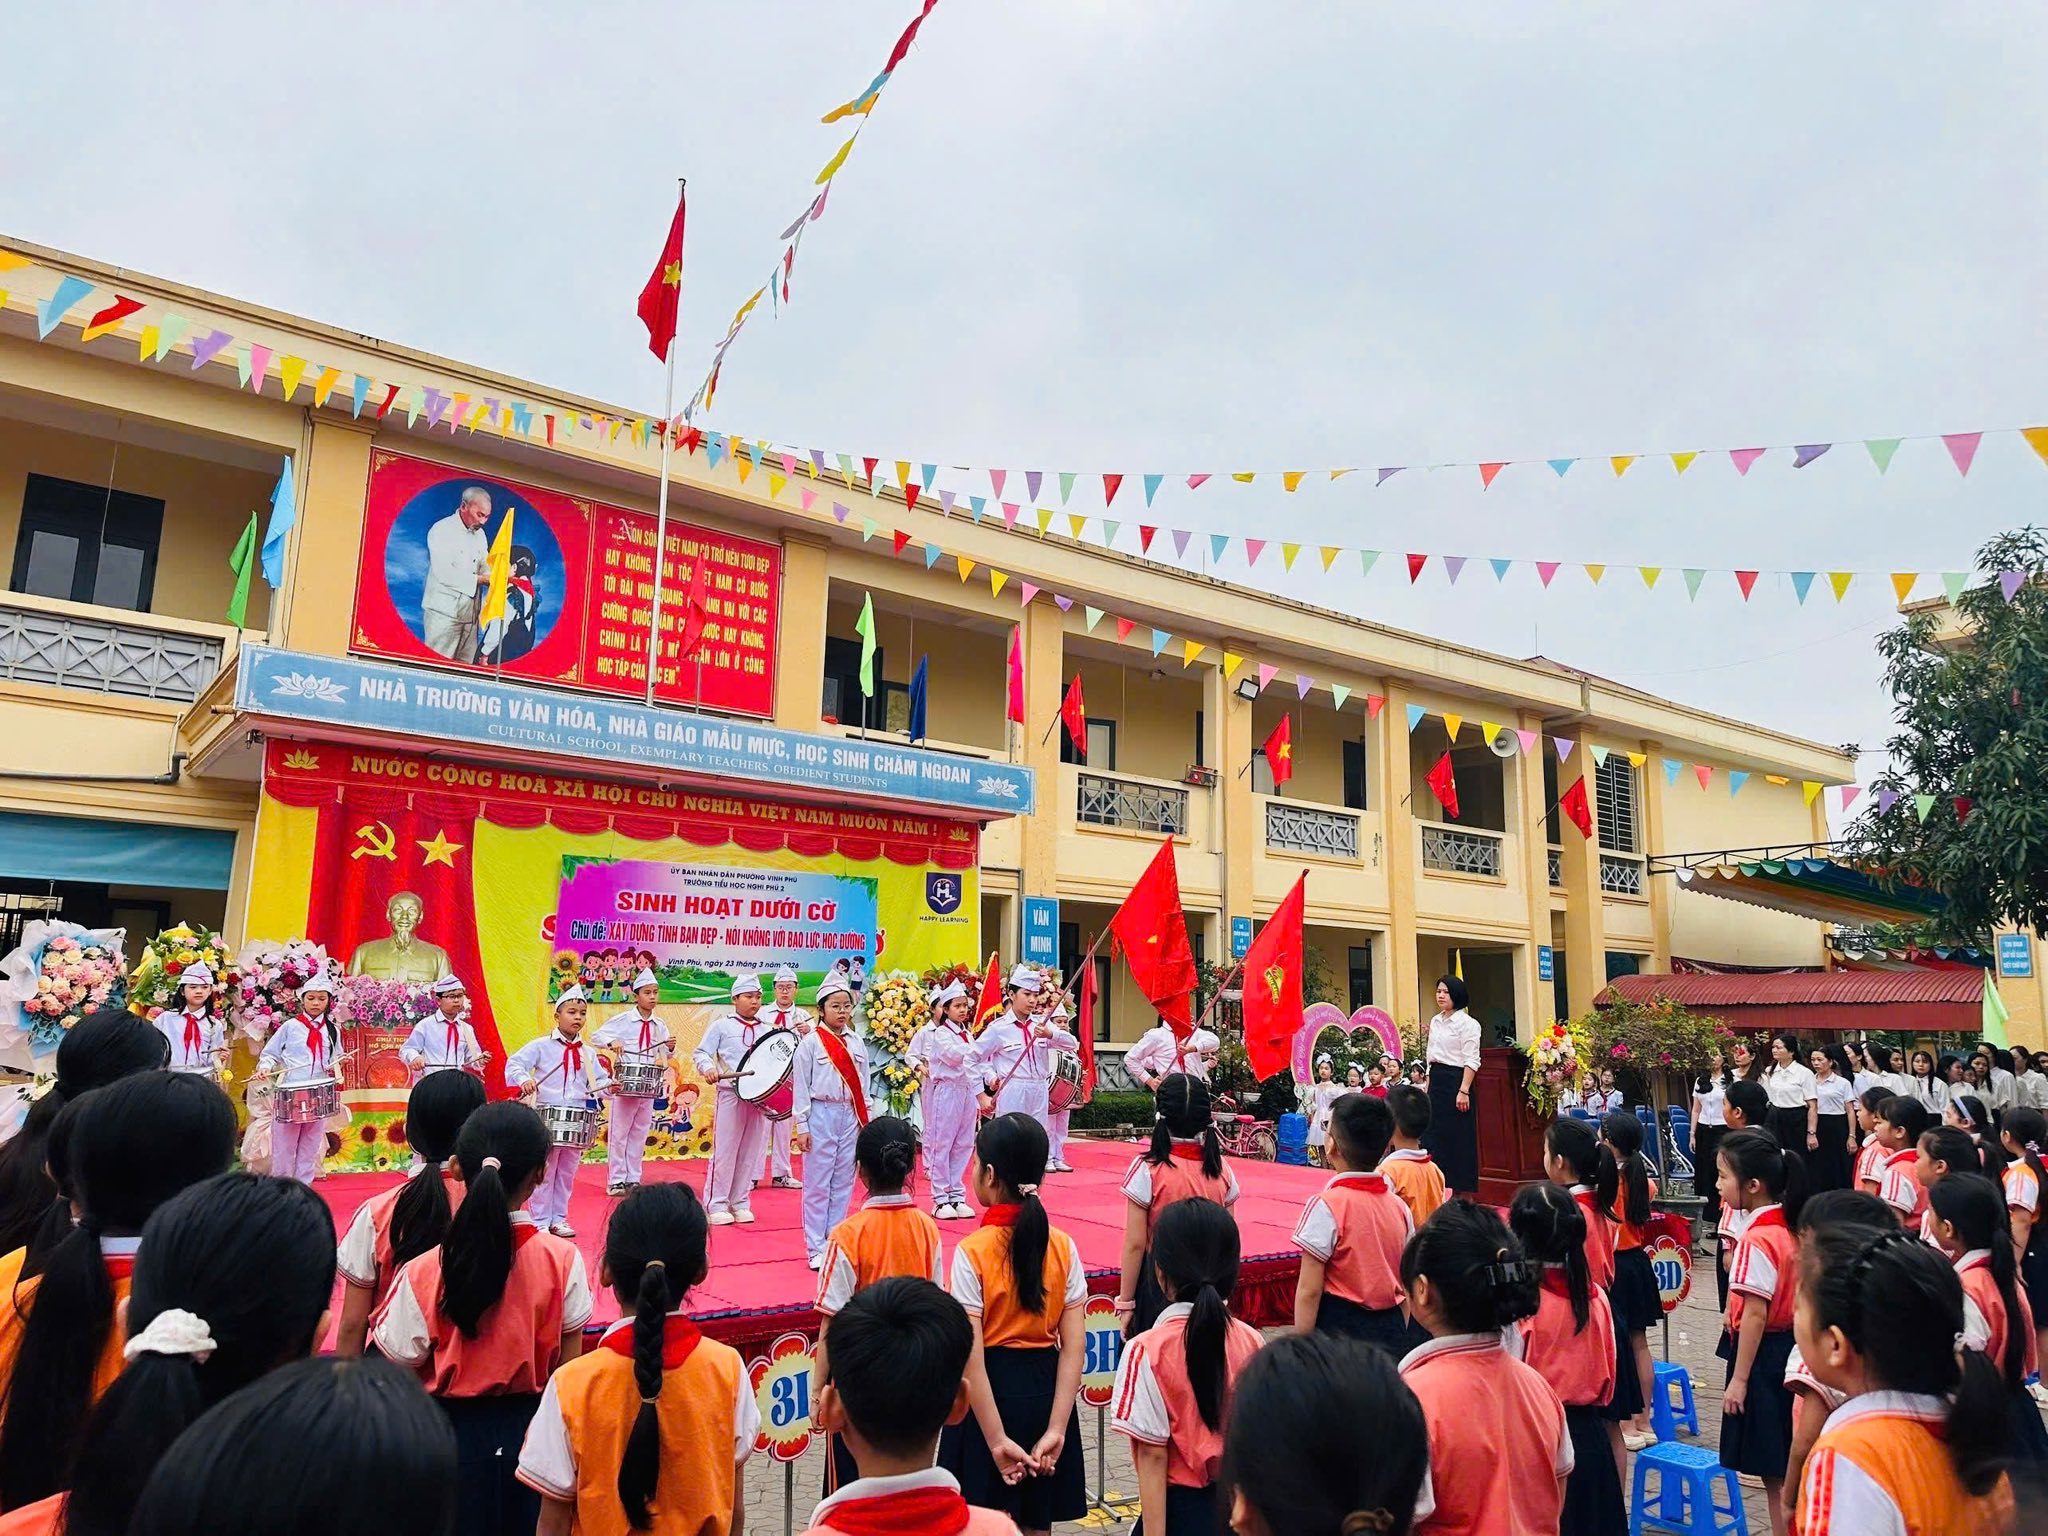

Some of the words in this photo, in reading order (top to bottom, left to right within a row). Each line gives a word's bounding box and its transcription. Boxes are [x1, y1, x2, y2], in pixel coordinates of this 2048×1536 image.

[605, 548, 621, 566] HAY
[663, 559, 673, 577] ÂN
[679, 562, 692, 583] TỘC
[716, 574, 732, 591] NAM
[737, 576, 746, 593] CÓ
[750, 580, 768, 598] BƯỚC
[666, 534, 681, 555] VIỆT
[682, 540, 698, 557] NAM
[756, 557, 770, 575] ĐẸP
[604, 573, 616, 592] TỚI
[724, 600, 735, 618] VAI
[739, 602, 750, 620] VỚI
[753, 606, 767, 624] CÁC
[602, 601, 628, 622] CƯỜNG
[724, 626, 737, 643] HAY
[597, 656, 613, 677] HỌC
[600, 628, 626, 649] CHÍNH
[630, 633, 641, 652] LÀ
[715, 649, 730, 668] LỚN
[744, 655, 764, 675] CÔNG
[359, 676, 407, 703] NHÀ
[415, 685, 501, 717] TRƯỜNG
[508, 697, 550, 725] VĂN
[556, 705, 602, 734] HÓA,
[608, 715, 648, 738] NHÀ
[654, 721, 697, 745] GIÁO
[702, 725, 743, 751] MẪU
[747, 736, 790, 761] MỰC,
[795, 743, 828, 766] HỌC
[833, 748, 869, 771] SINH
[874, 755, 917, 777] CHĂM
[921, 762, 971, 785] NGOAN
[487, 724, 563, 744] CULTURAL
[567, 736, 627, 754] SCHOOL,
[630, 745, 705, 764] EXEMPLARY
[773, 764, 831, 781] OBEDIENT
[833, 772, 888, 788] STUDENTS
[351, 755, 419, 779] NƯỚC
[426, 763, 493, 787] CỘNG
[498, 774, 548, 795] HOÀ
[553, 779, 586, 798] XÃ
[592, 784, 631, 805] HỘI
[637, 790, 678, 809] CHỦ
[683, 795, 745, 818] NGHĨA
[749, 802, 790, 823] VIỆT
[794, 809, 834, 826] NAM
[838, 814, 888, 832] MUÔN
[892, 819, 929, 836] NĂM
[682, 868, 697, 876] BAN
[698, 869, 718, 877] NHÂN
[720, 870, 735, 879] DÂN
[683, 878, 713, 887] TRƯỜNG
[714, 878, 728, 888] TIỂU
[729, 882, 746, 890] HỌC
[617, 891, 677, 913] SINH
[684, 896, 744, 919] HOẠT
[750, 897, 801, 920] DƯỚI
[807, 899, 837, 921] CỜ
[1033, 906, 1050, 926] VĂN
[571, 918, 589, 940] Chủ
[591, 917, 606, 940] đề:
[608, 919, 629, 940] XÂY
[630, 921, 655, 945] DỰNG
[657, 922, 678, 943] TÌNH
[680, 926, 699, 947] BẠN
[700, 927, 718, 948] ĐẸP
[725, 925, 741, 946] NÓI
[742, 926, 770, 947] KHÔNG
[773, 926, 785, 947] VỚI
[788, 931, 803, 951] BẠO
[805, 930, 820, 952] LỰC
[822, 932, 838, 953] HỌC
[840, 929, 865, 951] ĐƯỜNG
[1030, 935, 1052, 953] MINH
[704, 959, 723, 968] ngày
[736, 960, 757, 969] tháng
[1654, 1260, 1682, 1291] 3D
[771, 1370, 810, 1427] 3I
